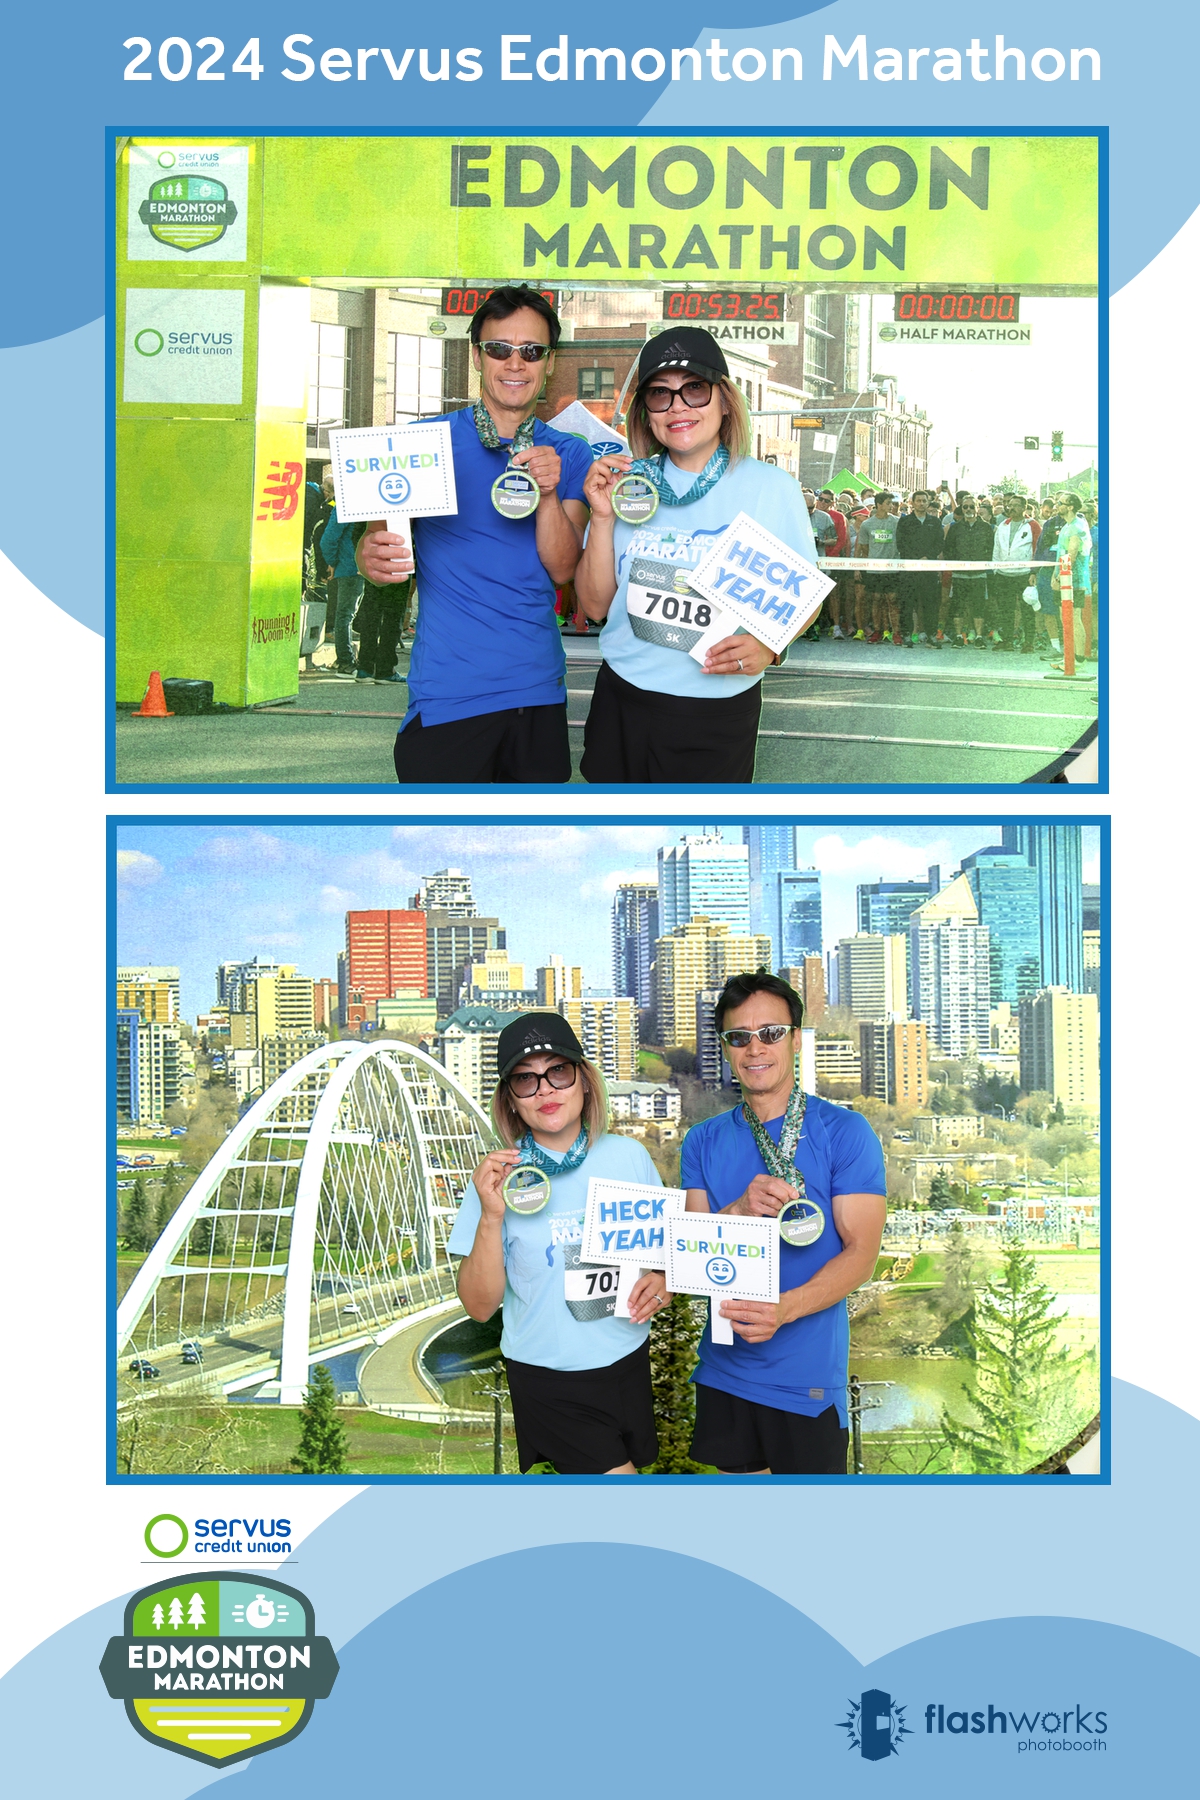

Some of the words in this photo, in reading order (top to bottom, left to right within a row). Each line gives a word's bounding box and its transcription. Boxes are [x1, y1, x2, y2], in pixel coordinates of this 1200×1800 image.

[178, 152, 219, 162] servus
[450, 145, 990, 211] EDMONTON
[150, 203, 227, 213] EDMONTON
[160, 214, 215, 222] MARATHON
[524, 224, 906, 271] MARATHON
[168, 332, 233, 345] servus
[702, 326, 784, 340] RATHON
[900, 328, 939, 340] HALF
[943, 329, 1031, 341] MARATHON
[168, 344, 200, 355] credit
[203, 346, 233, 355] union
[387, 437, 393, 452] I
[345, 453, 440, 474] SURVIVED!
[633, 530, 661, 542] 2024
[675, 534, 718, 547] EDMO
[725, 539, 808, 598] HECK
[711, 566, 796, 626] YEAH!
[645, 592, 711, 627] 7018
[666, 632, 681, 643] 5K
[598, 1199, 667, 1224] HECK
[549, 1217, 578, 1229] 2024
[717, 1225, 722, 1239] I
[676, 1238, 766, 1259] SURVIVED!
[606, 1303, 616, 1312] 5K
